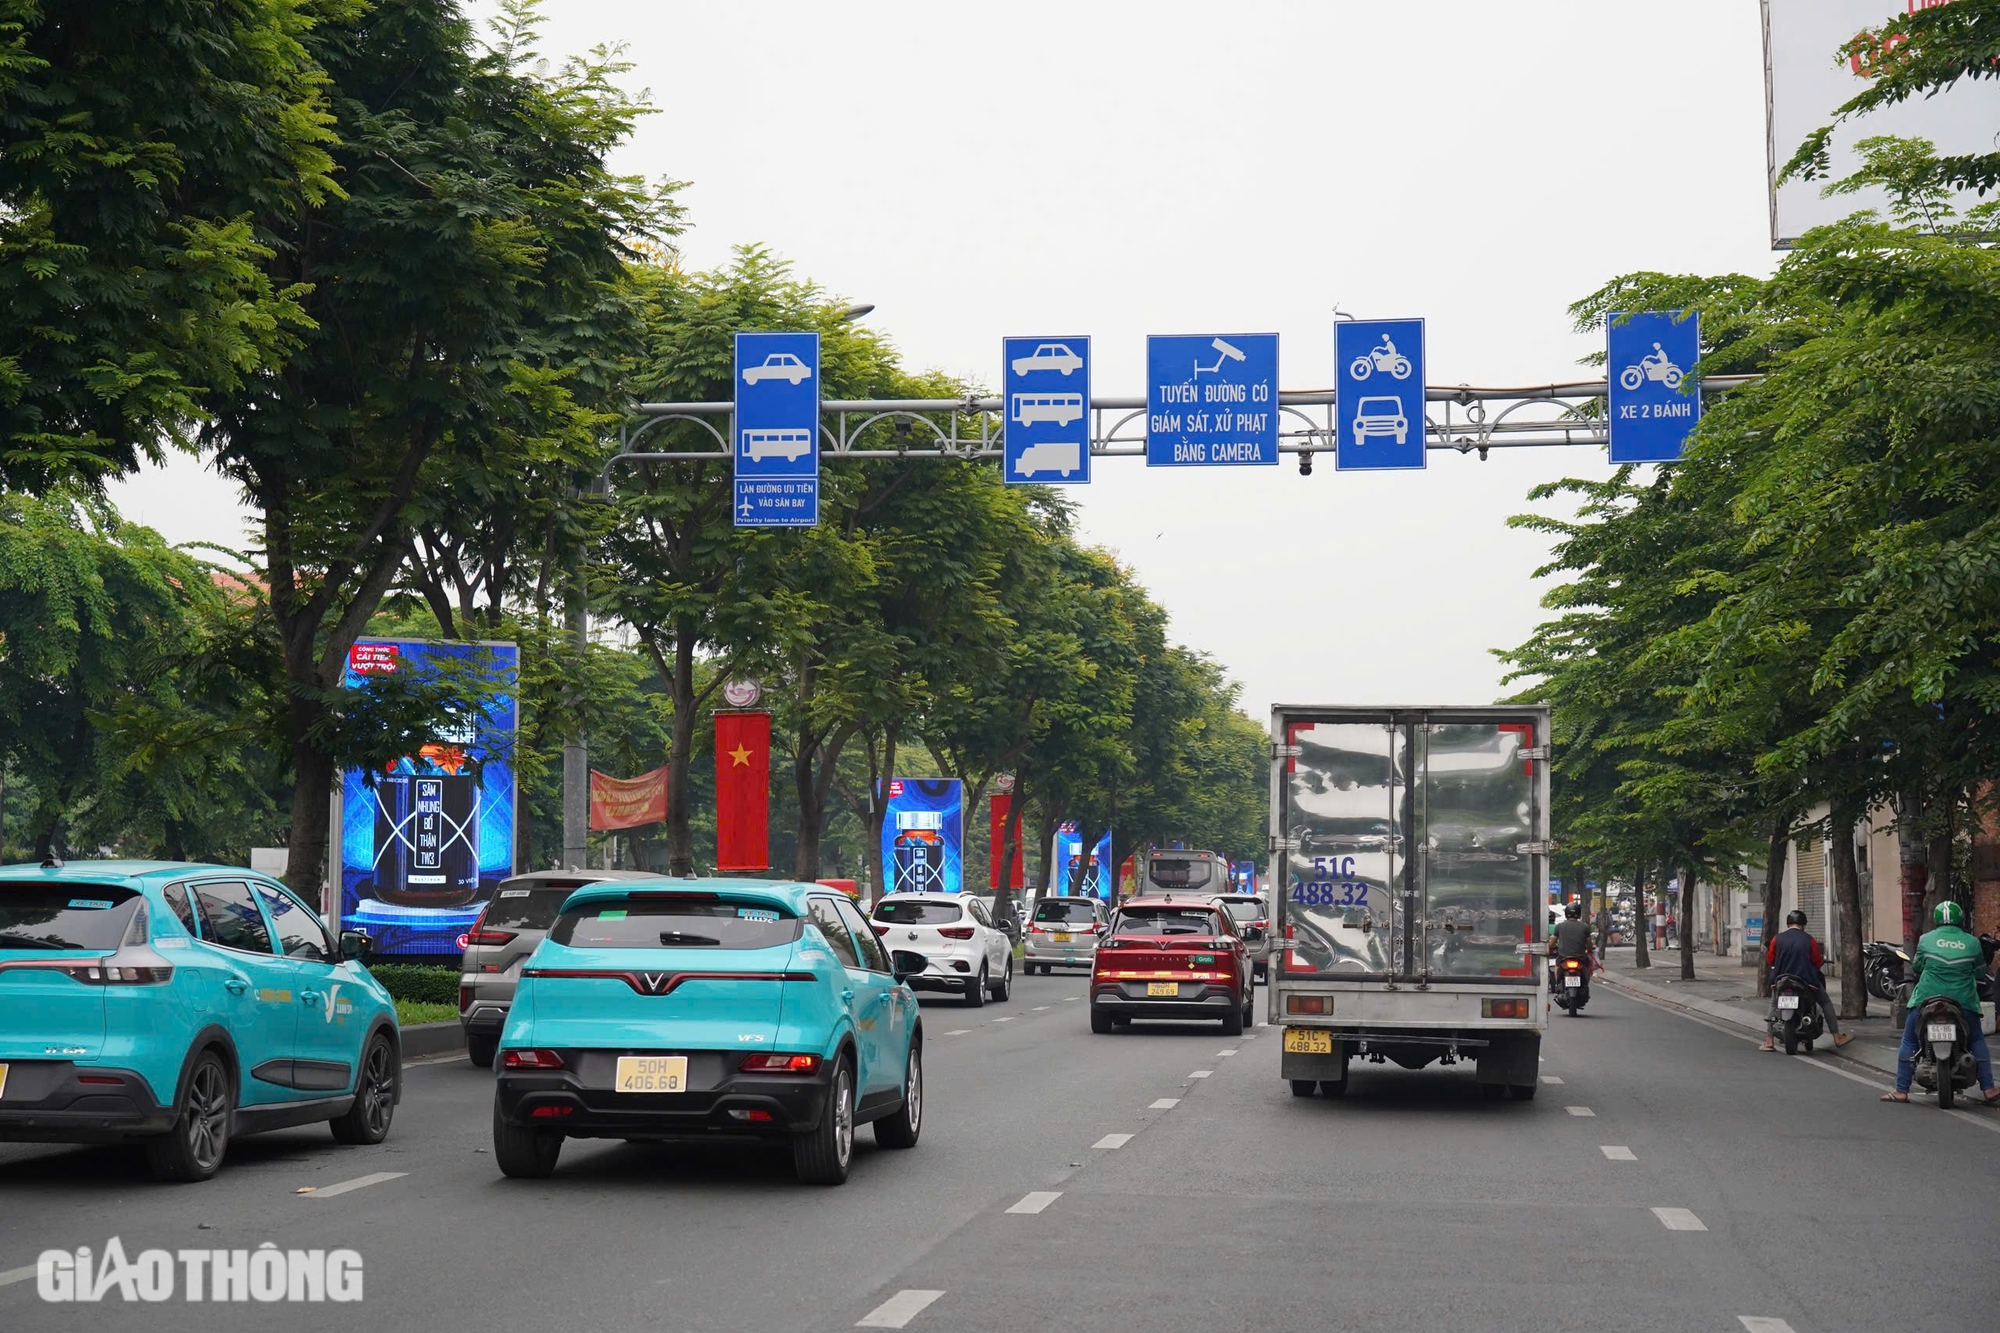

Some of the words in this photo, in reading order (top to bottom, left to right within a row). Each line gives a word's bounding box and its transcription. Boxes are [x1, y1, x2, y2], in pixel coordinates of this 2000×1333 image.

[1160, 378, 1198, 403] TUYẾN
[1204, 378, 1246, 402] ĐƯỜNG
[1252, 379, 1268, 401] CÓ
[1620, 405, 1637, 419] XE
[1641, 405, 1650, 418] 2
[1653, 400, 1691, 418] BÁNH
[1151, 411, 1181, 432] GIÁM
[1215, 408, 1232, 431] XỬ
[1236, 413, 1268, 435] PHẠT
[1174, 436, 1206, 462] BẰNG
[1211, 443, 1262, 461] CAMERA
[740, 482, 755, 494] LÀN
[756, 482, 782, 494] ĐƯỜNG
[783, 484, 795, 493] ƯU
[796, 483, 814, 493] TIÊN
[758, 496, 773, 507] VÀO
[774, 497, 790, 507] SÂN
[791, 498, 806, 507] BAY
[356, 652, 371, 661] CẢI
[352, 662, 376, 672] VƯỢT
[422, 782, 436, 797] SÂM
[417, 801, 440, 813] NHUNG
[423, 814, 434, 830] BỔ
[420, 832, 437, 849] THẬN
[420, 852, 435, 865] TW3
[1314, 857, 1355, 879] 51C
[1292, 881, 1369, 906] 488.32
[1936, 938, 1966, 949] Grab
[1198, 955, 1213, 963] Grab
[737, 1034, 765, 1042] VF5
[1298, 1030, 1319, 1041] 51C
[1290, 1041, 1327, 1052] 488.32
[637, 1060, 667, 1074] 50H
[624, 1075, 678, 1090] 406.68
